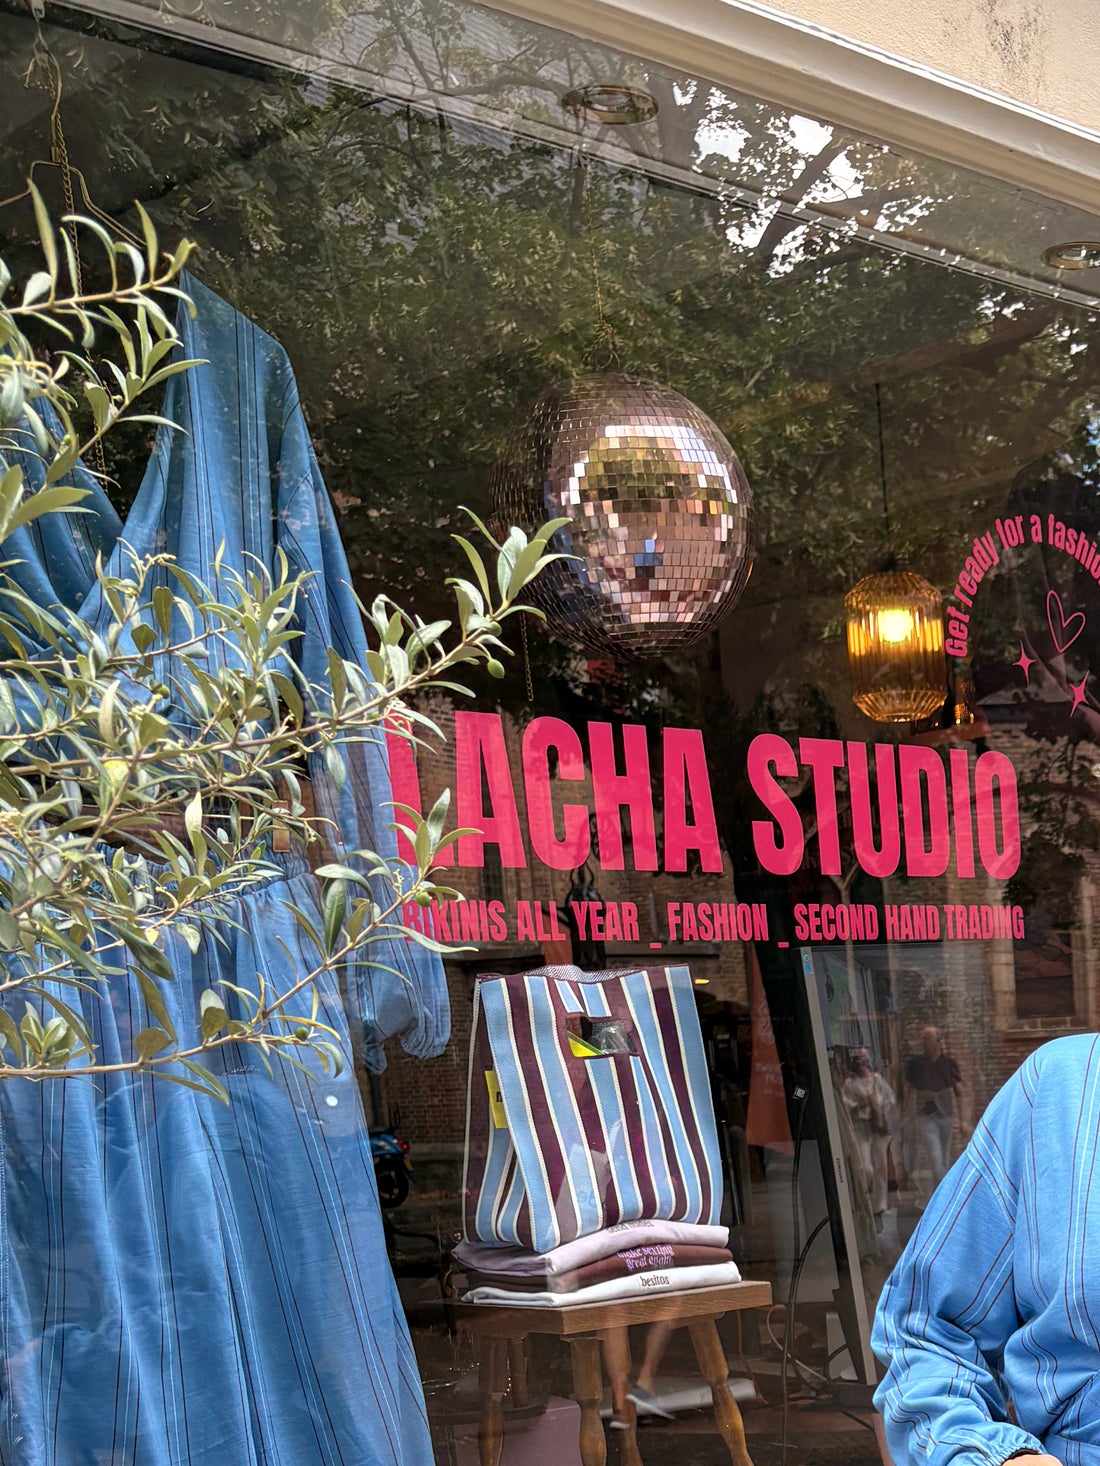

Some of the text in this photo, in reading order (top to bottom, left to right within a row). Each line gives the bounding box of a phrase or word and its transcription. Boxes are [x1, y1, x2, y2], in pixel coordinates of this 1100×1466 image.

[994, 514, 1024, 551] for
[1030, 514, 1043, 544] a
[953, 530, 1001, 608] ready
[945, 605, 970, 658] Get
[384, 704, 1021, 881] LACHA STUDIO
[402, 899, 507, 943] BIKINIS
[516, 901, 567, 943] ALL
[571, 901, 640, 942] YEAR
[667, 902, 769, 942] FASHION
[794, 904, 879, 941] SECOND
[885, 905, 940, 941] HAND
[943, 905, 1025, 941] TRADING
[639, 1275, 670, 1287] besitos
